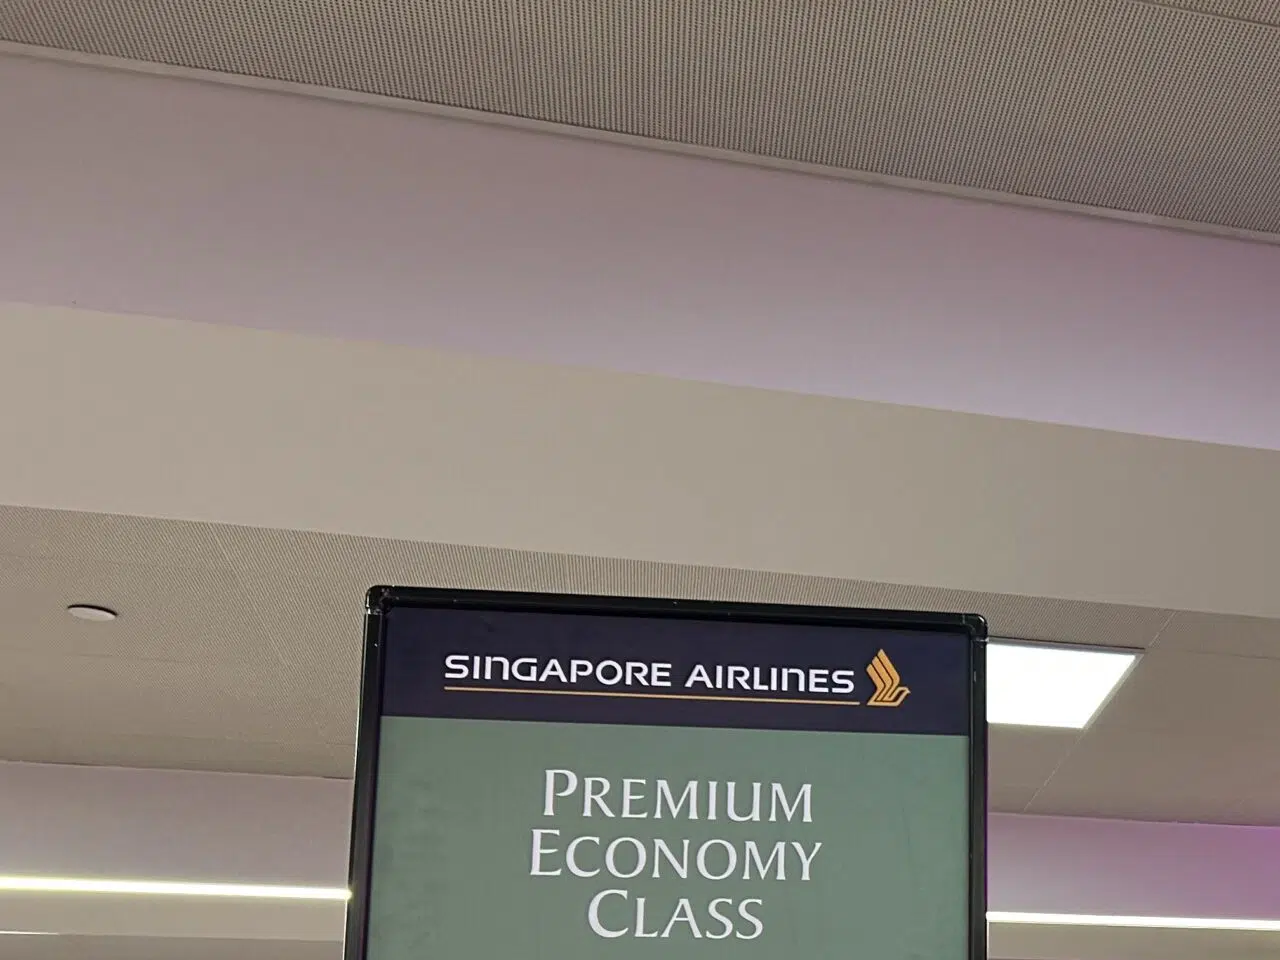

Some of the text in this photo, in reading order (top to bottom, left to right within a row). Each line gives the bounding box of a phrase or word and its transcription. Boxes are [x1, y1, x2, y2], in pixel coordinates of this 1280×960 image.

[444, 654, 855, 694] SINGAPORE AIRLINES
[543, 769, 814, 823] PREMIUM
[530, 828, 823, 881] ECONOMY
[588, 889, 764, 940] CLASS
